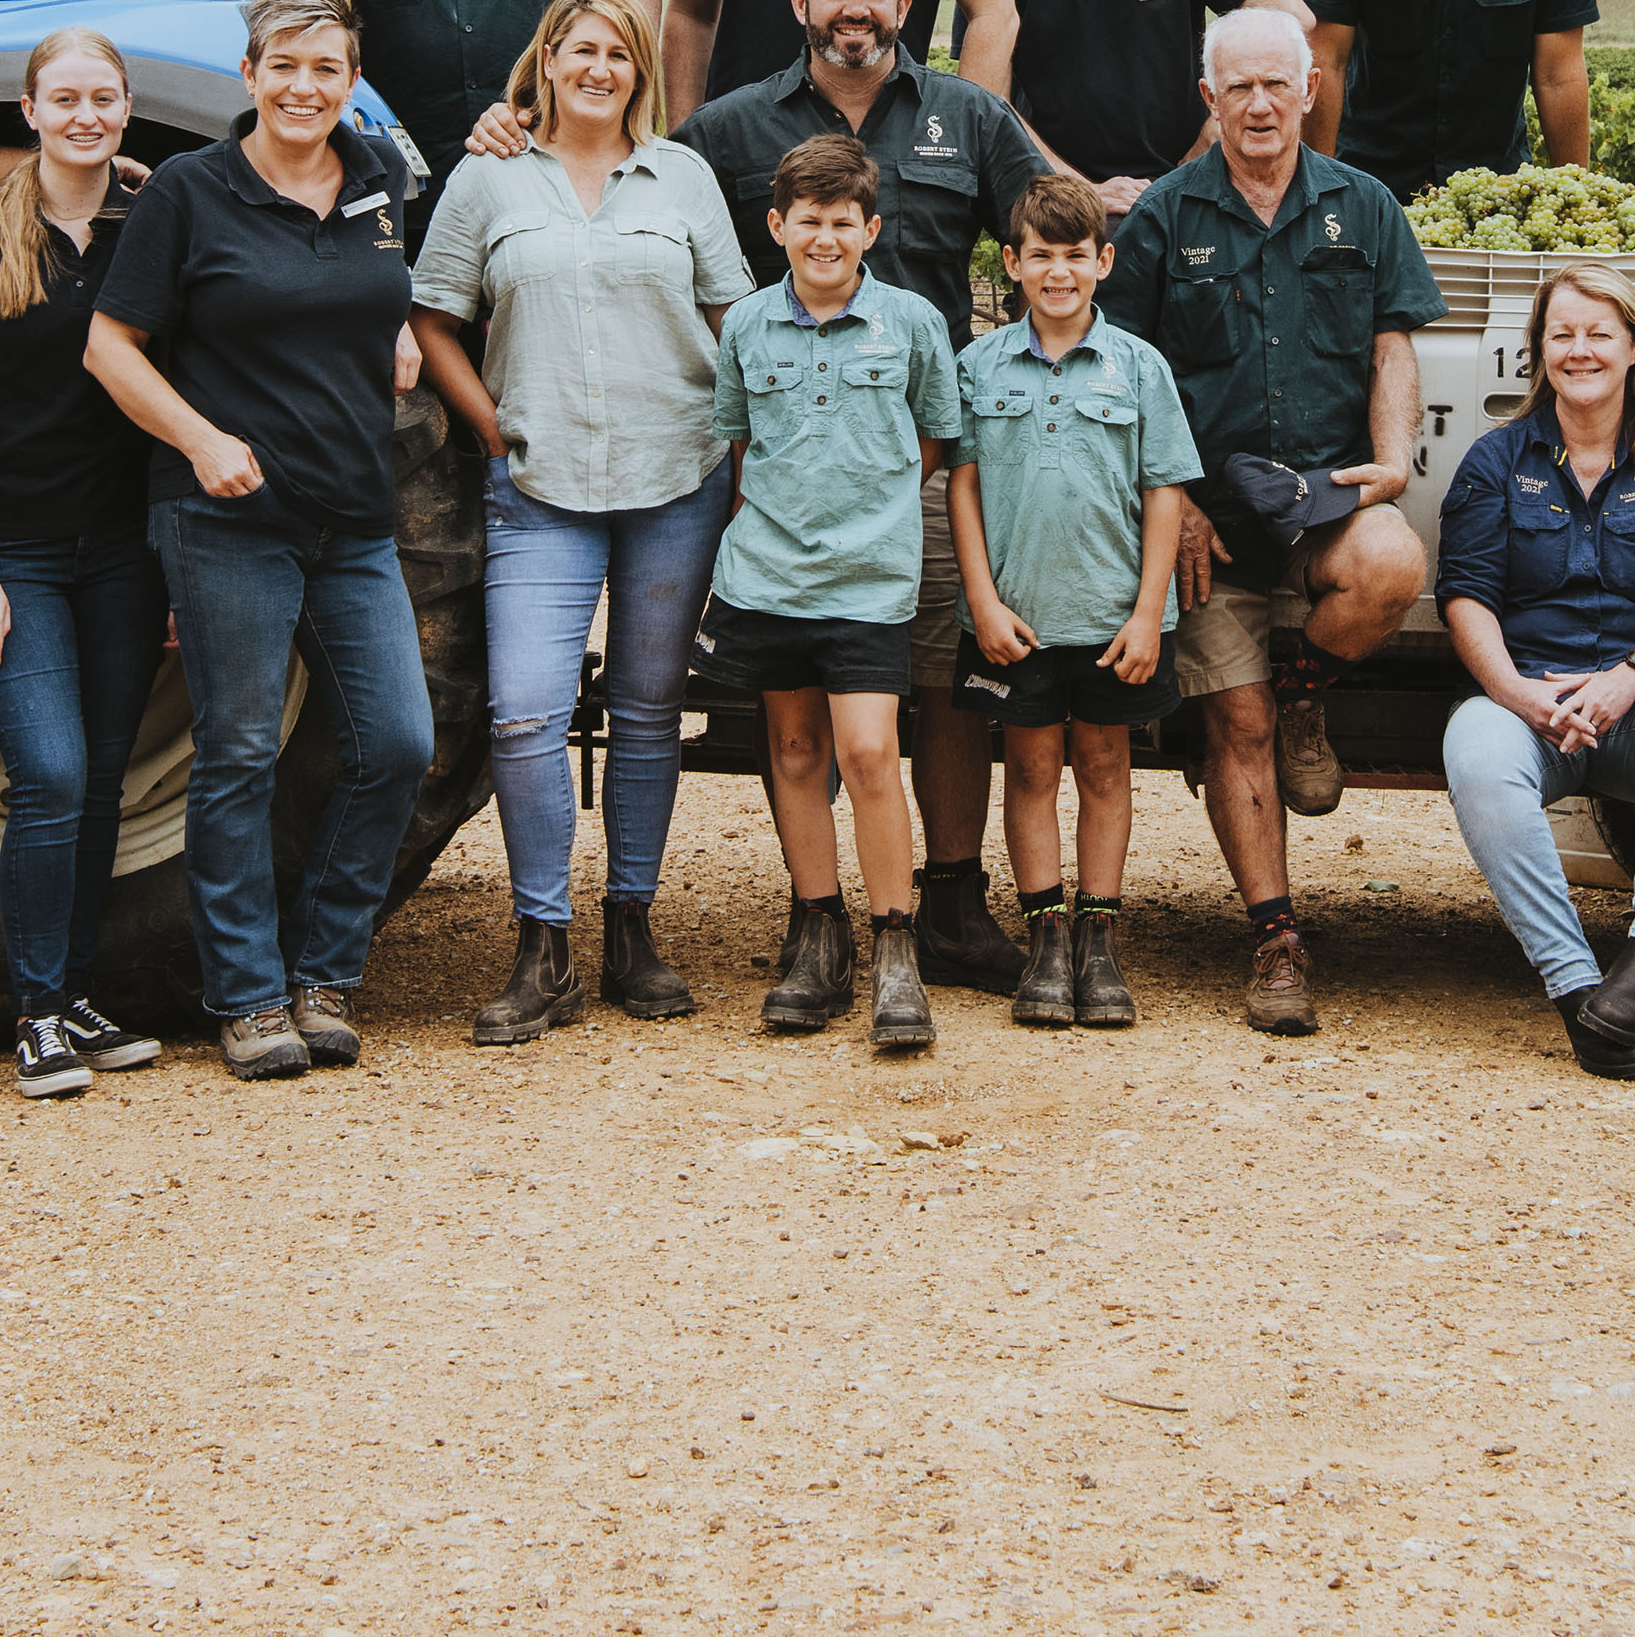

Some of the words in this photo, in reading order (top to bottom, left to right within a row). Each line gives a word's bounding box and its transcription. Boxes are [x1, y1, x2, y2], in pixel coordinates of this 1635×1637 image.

[1181, 246, 1216, 256] Vintage
[1189, 255, 1209, 265] 2021
[1515, 474, 1549, 488] Vintage
[1521, 484, 1540, 494] 2021
